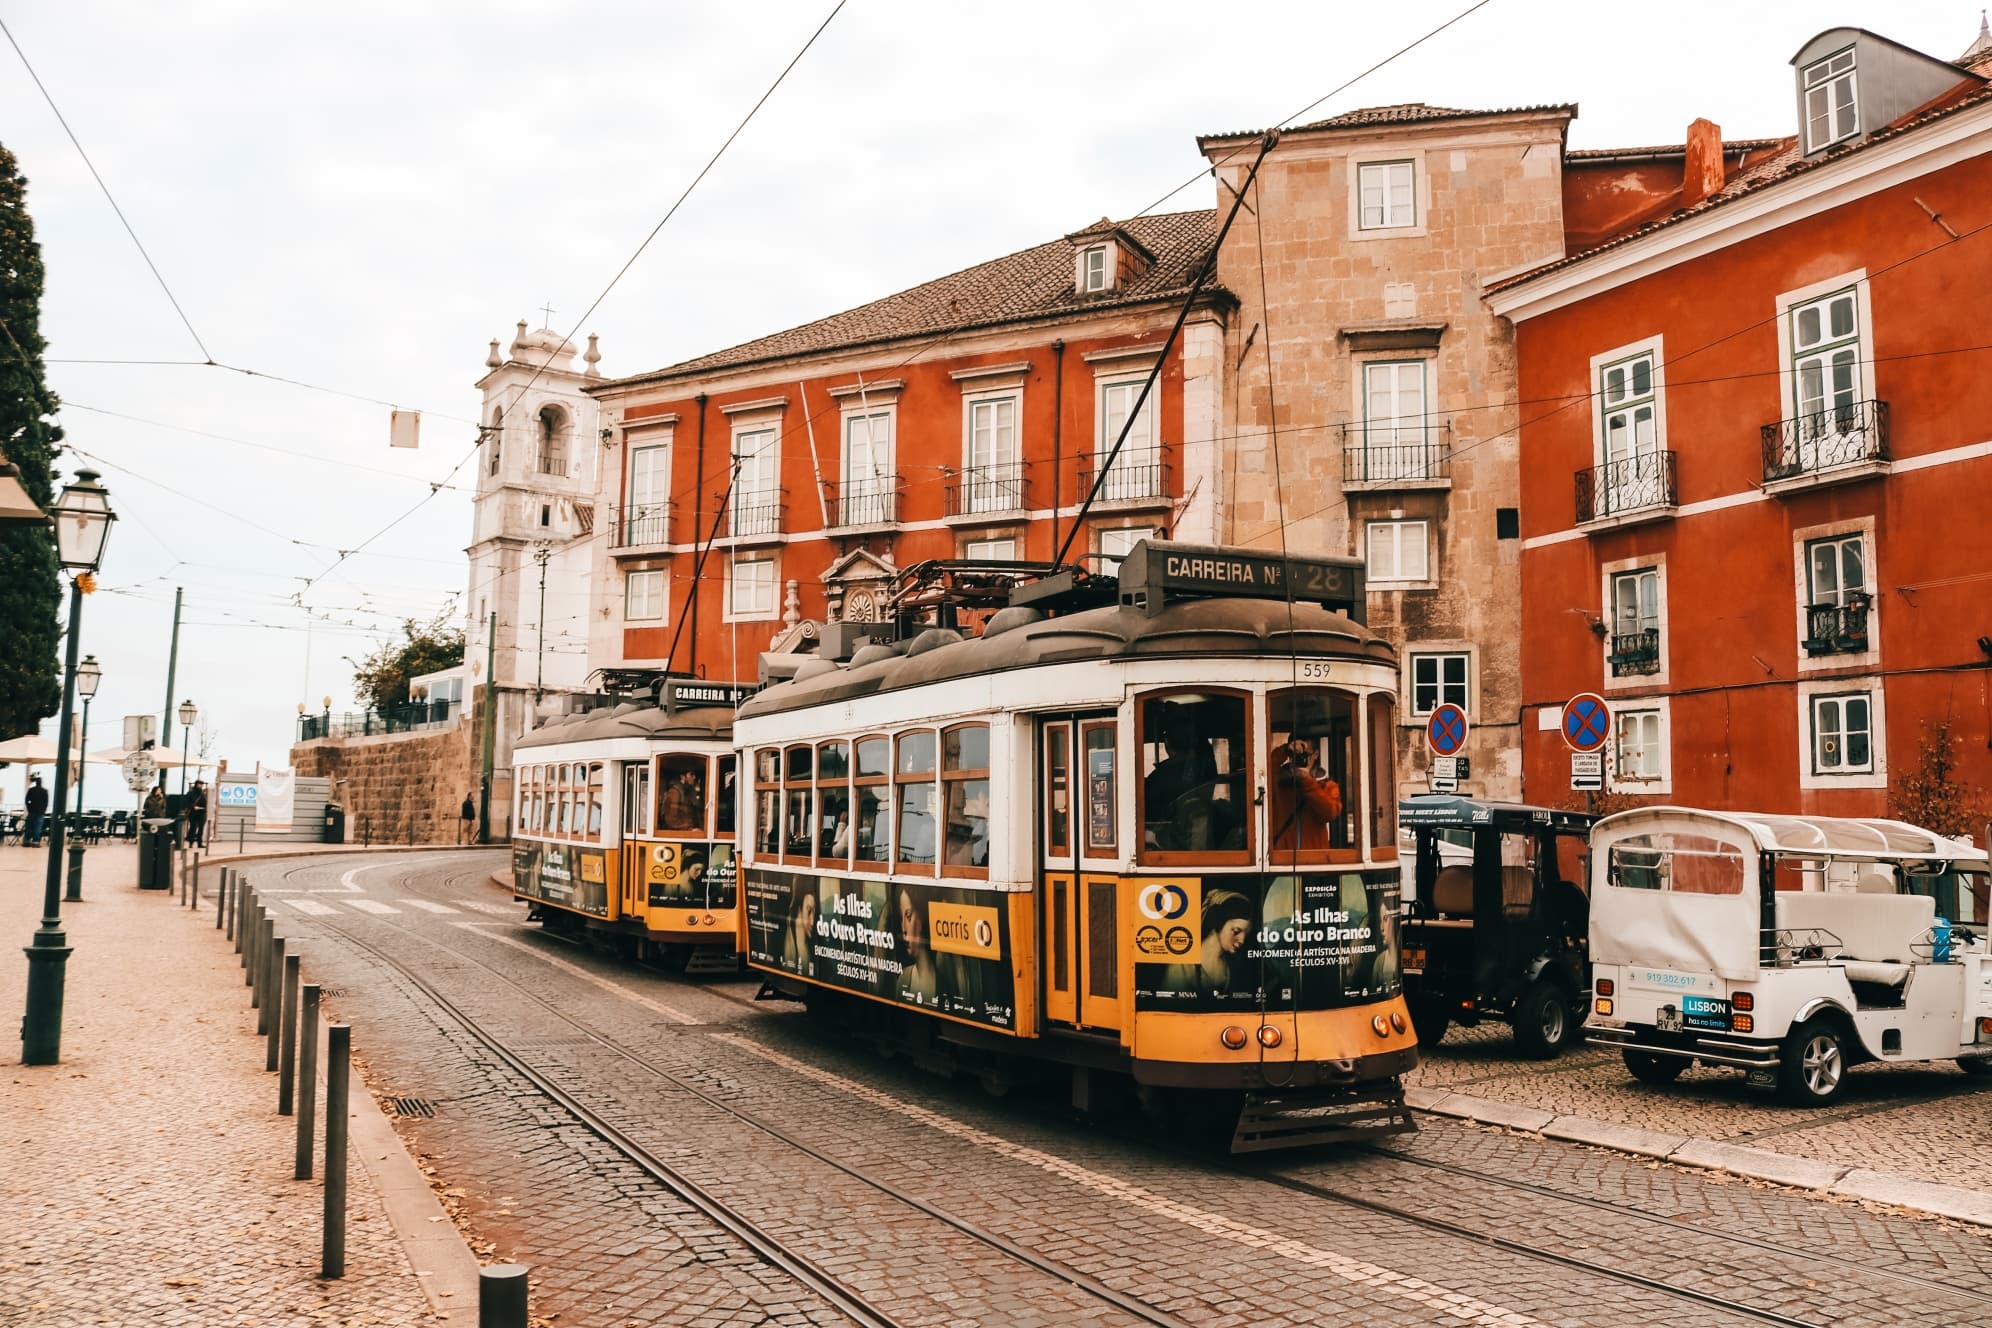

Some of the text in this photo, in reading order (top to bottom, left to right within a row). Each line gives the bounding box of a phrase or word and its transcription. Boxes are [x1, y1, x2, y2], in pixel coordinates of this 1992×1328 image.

[1167, 557, 1254, 583] CARREIRA
[1307, 566, 1342, 591] 28
[1303, 663, 1331, 678] 559
[675, 687, 725, 701] CARREIRA
[706, 867, 718, 876] do
[1305, 884, 1337, 892] EXPOSIÇÃO
[833, 893, 872, 919] As Ilhas
[1290, 907, 1349, 924] As Ilhas
[816, 915, 894, 950] do Ouro Branco
[935, 915, 970, 940] carris
[1256, 926, 1371, 943] do Ouro Branco
[1247, 944, 1376, 958] ENCOMENDA ARTÍSTICA NA MADEIRA
[814, 945, 844, 962] ENCOMENDA
[844, 950, 869, 968] ARTÍSTICA
[869, 956, 877, 968] NA
[878, 958, 903, 975] MADEIRA
[1290, 956, 1325, 967] SÉCULOS
[837, 964, 858, 979] SÉCULOS
[1647, 972, 1696, 985] 919 302 617
[1688, 1000, 1726, 1014] LISBON
[1673, 1022, 1684, 1031] 92
[1688, 1017, 1700, 1025] has
[1709, 1019, 1725, 1028] limits
